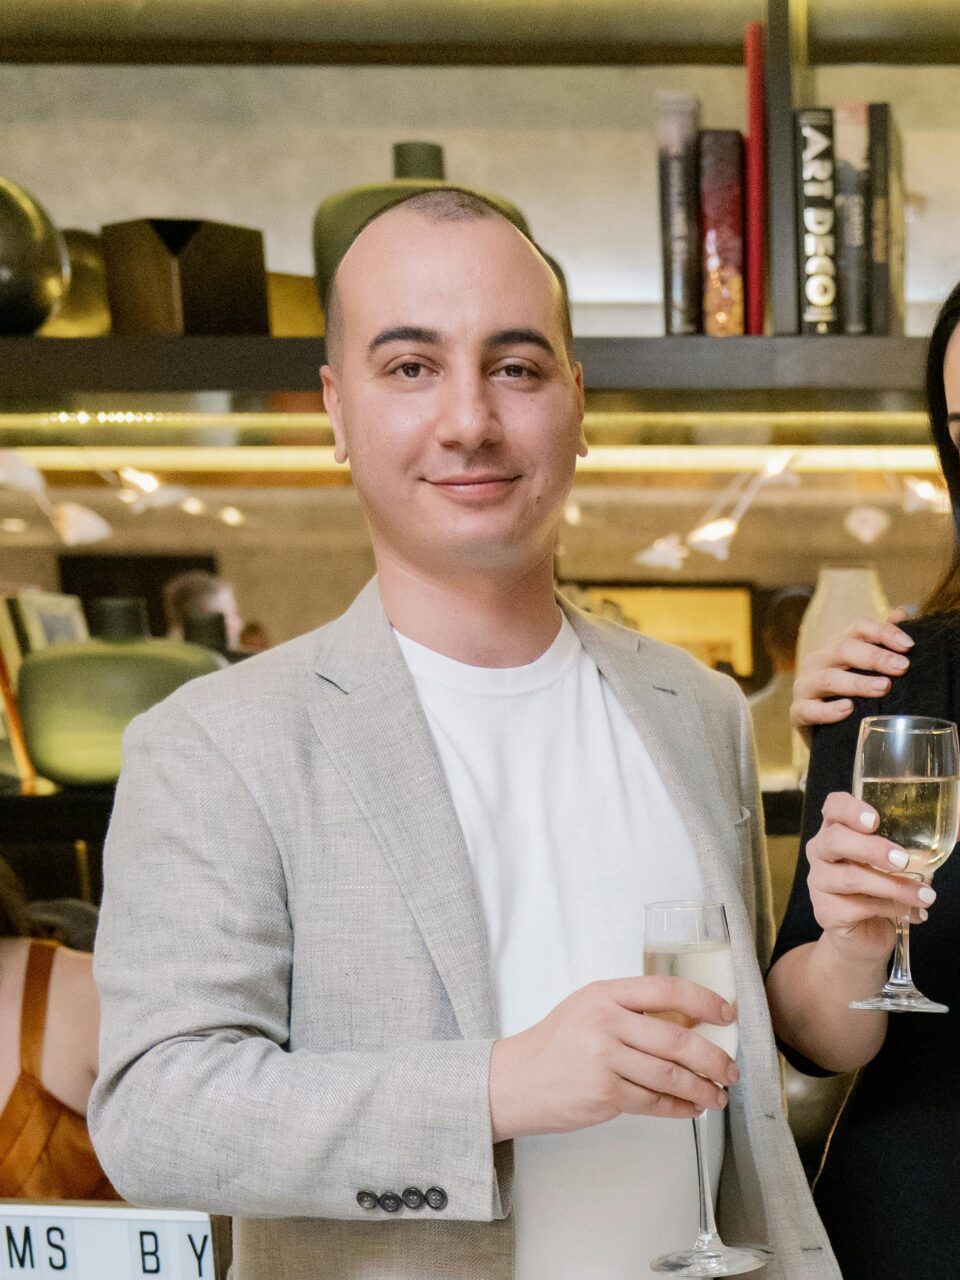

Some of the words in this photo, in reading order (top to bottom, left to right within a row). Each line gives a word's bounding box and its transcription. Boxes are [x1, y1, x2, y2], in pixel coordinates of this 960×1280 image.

[801, 125, 834, 199] ART
[803, 206, 836, 307] DECO
[6, 1226, 67, 1270] MS
[139, 1231, 209, 1278] BY
